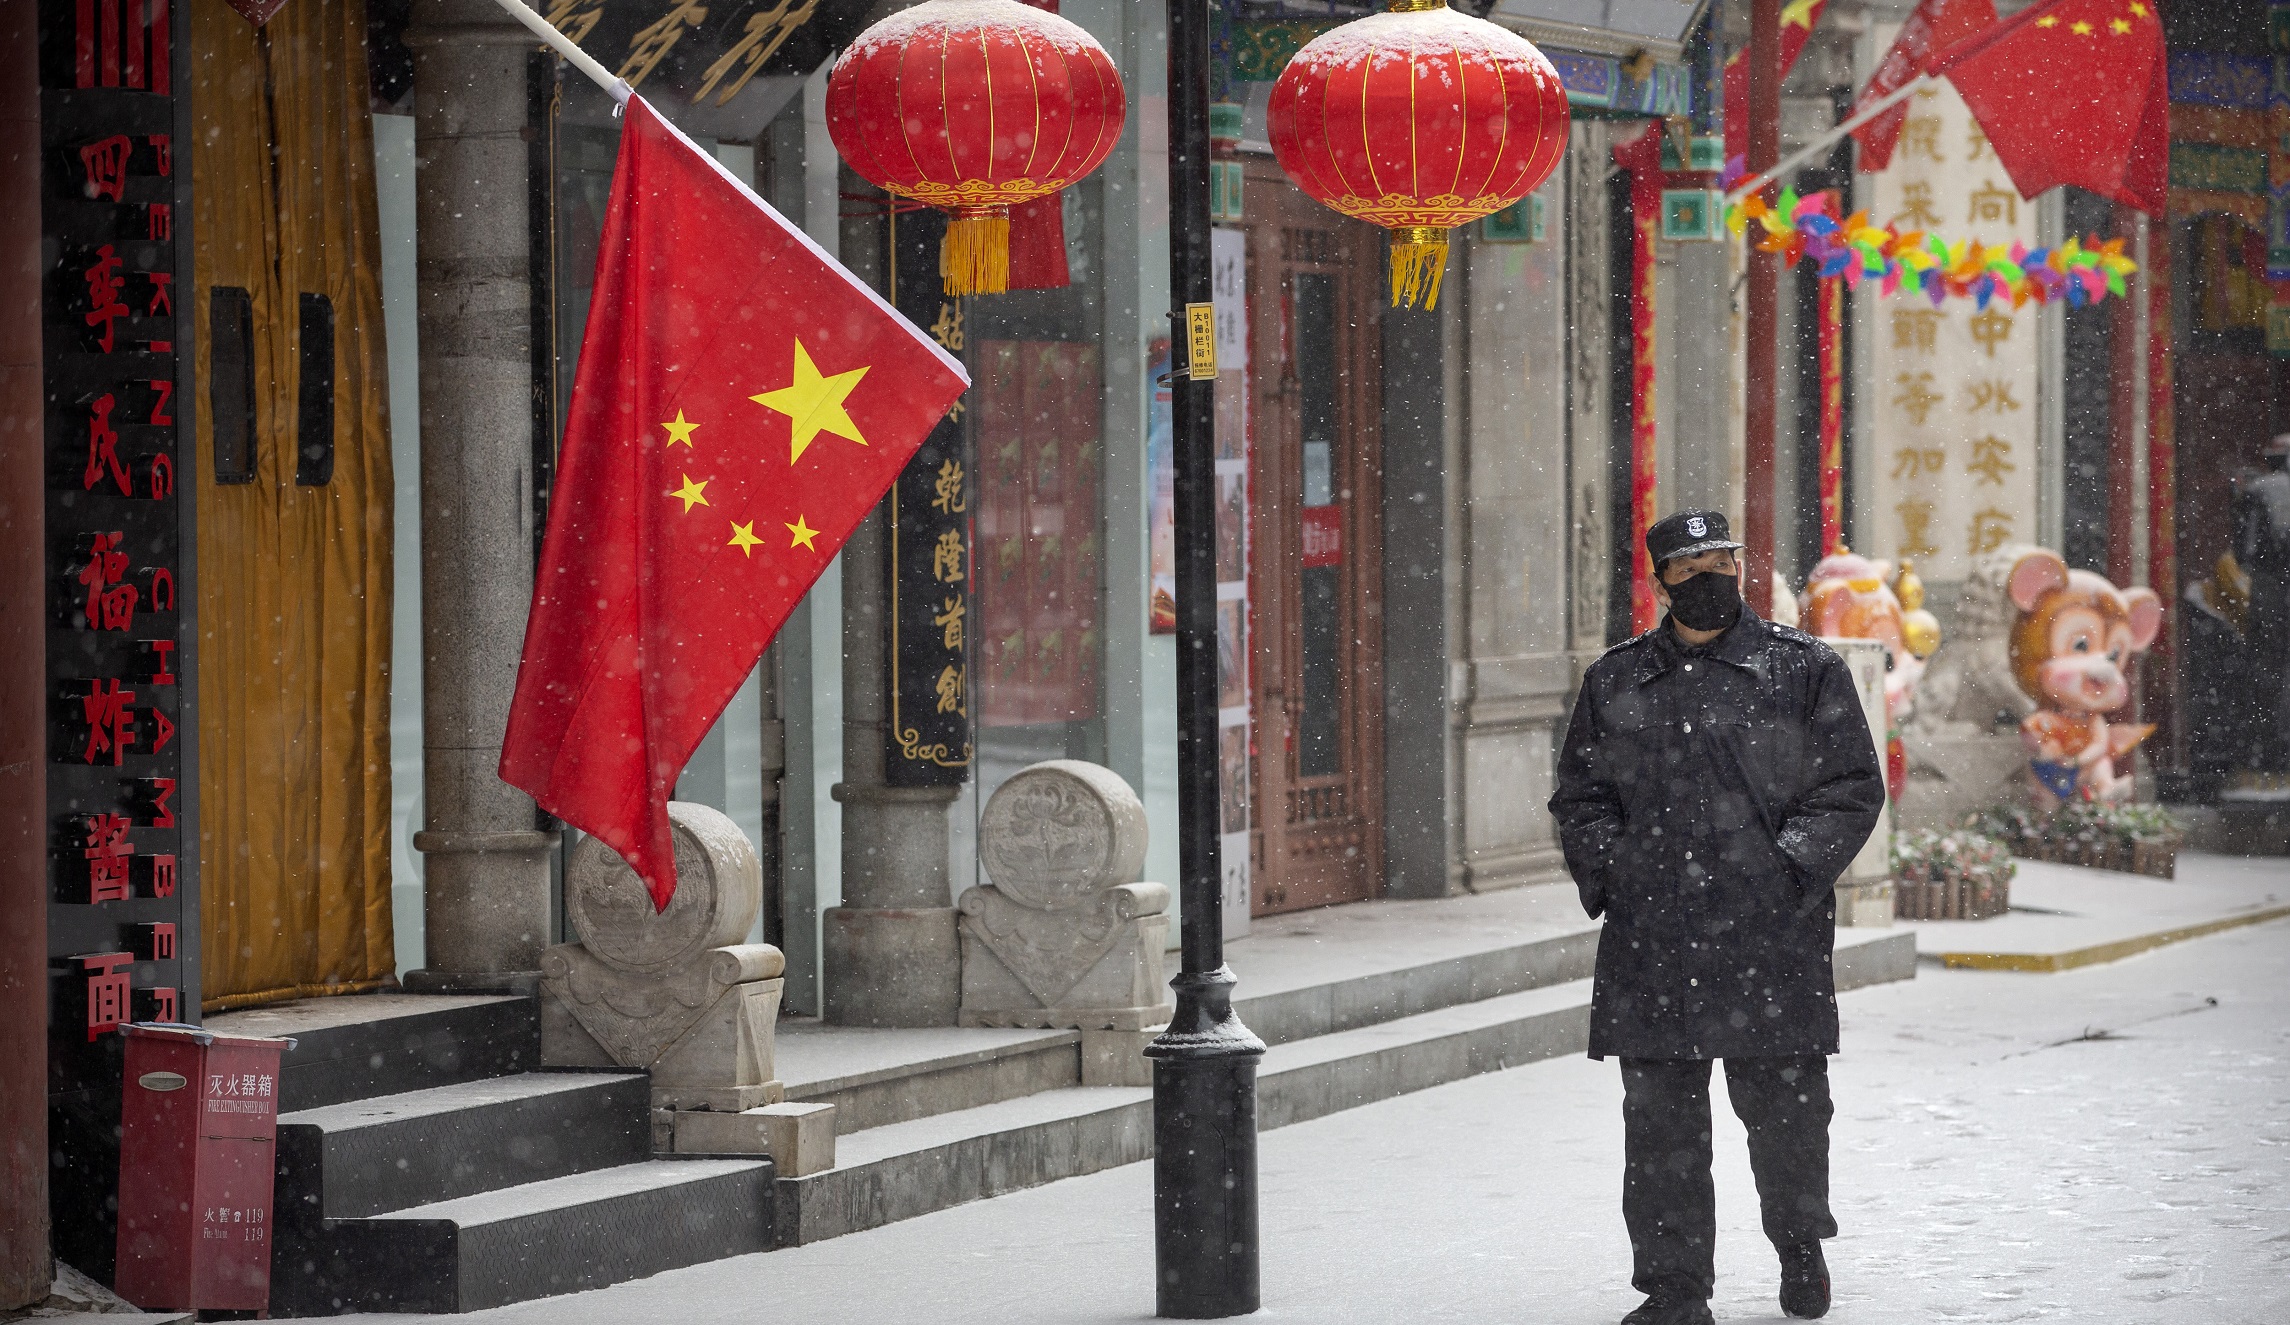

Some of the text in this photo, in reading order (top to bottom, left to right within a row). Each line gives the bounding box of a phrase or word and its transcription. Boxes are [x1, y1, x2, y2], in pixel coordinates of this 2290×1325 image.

[149, 134, 173, 500] PEKING
[1194, 312, 1205, 358] 大栅栏街
[1203, 313, 1211, 356] B10011
[151, 567, 176, 1024] CHAMBER
[208, 1073, 273, 1097] 灭火器箱
[208, 1099, 220, 1113] FIRE
[259, 1101, 270, 1114] BOX
[246, 1208, 264, 1223] 119
[244, 1227, 264, 1241] 119
